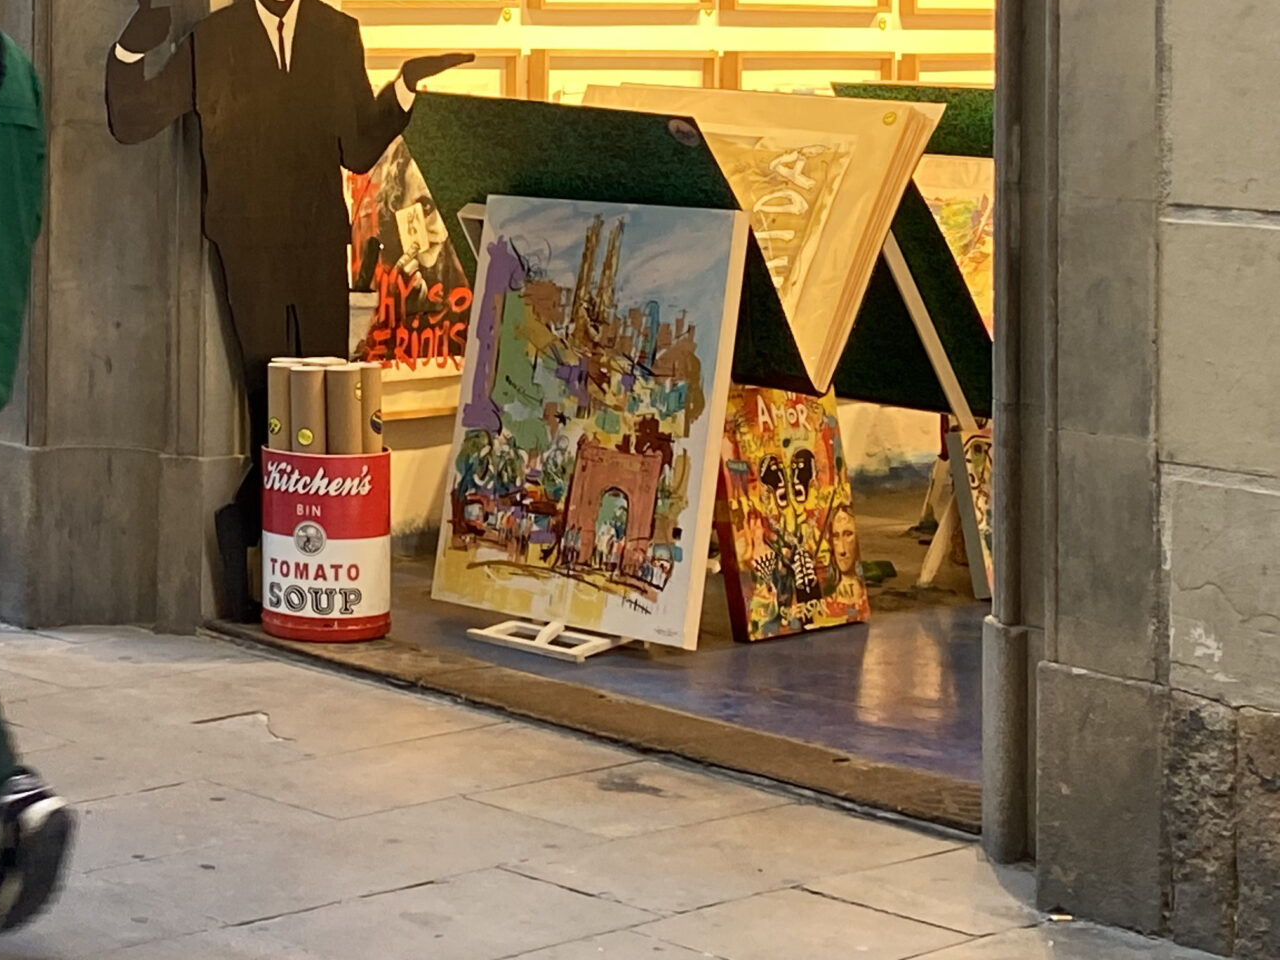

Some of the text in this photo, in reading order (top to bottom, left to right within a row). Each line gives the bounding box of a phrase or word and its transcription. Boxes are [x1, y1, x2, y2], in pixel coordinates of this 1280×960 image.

[376, 268, 422, 328] HY
[366, 320, 466, 373] ERIOUS
[757, 394, 812, 433] AMOR
[264, 460, 372, 497] Kitchen's
[296, 503, 321, 517] BIN
[270, 558, 360, 582] TOMATO
[268, 582, 362, 615] SOUP
